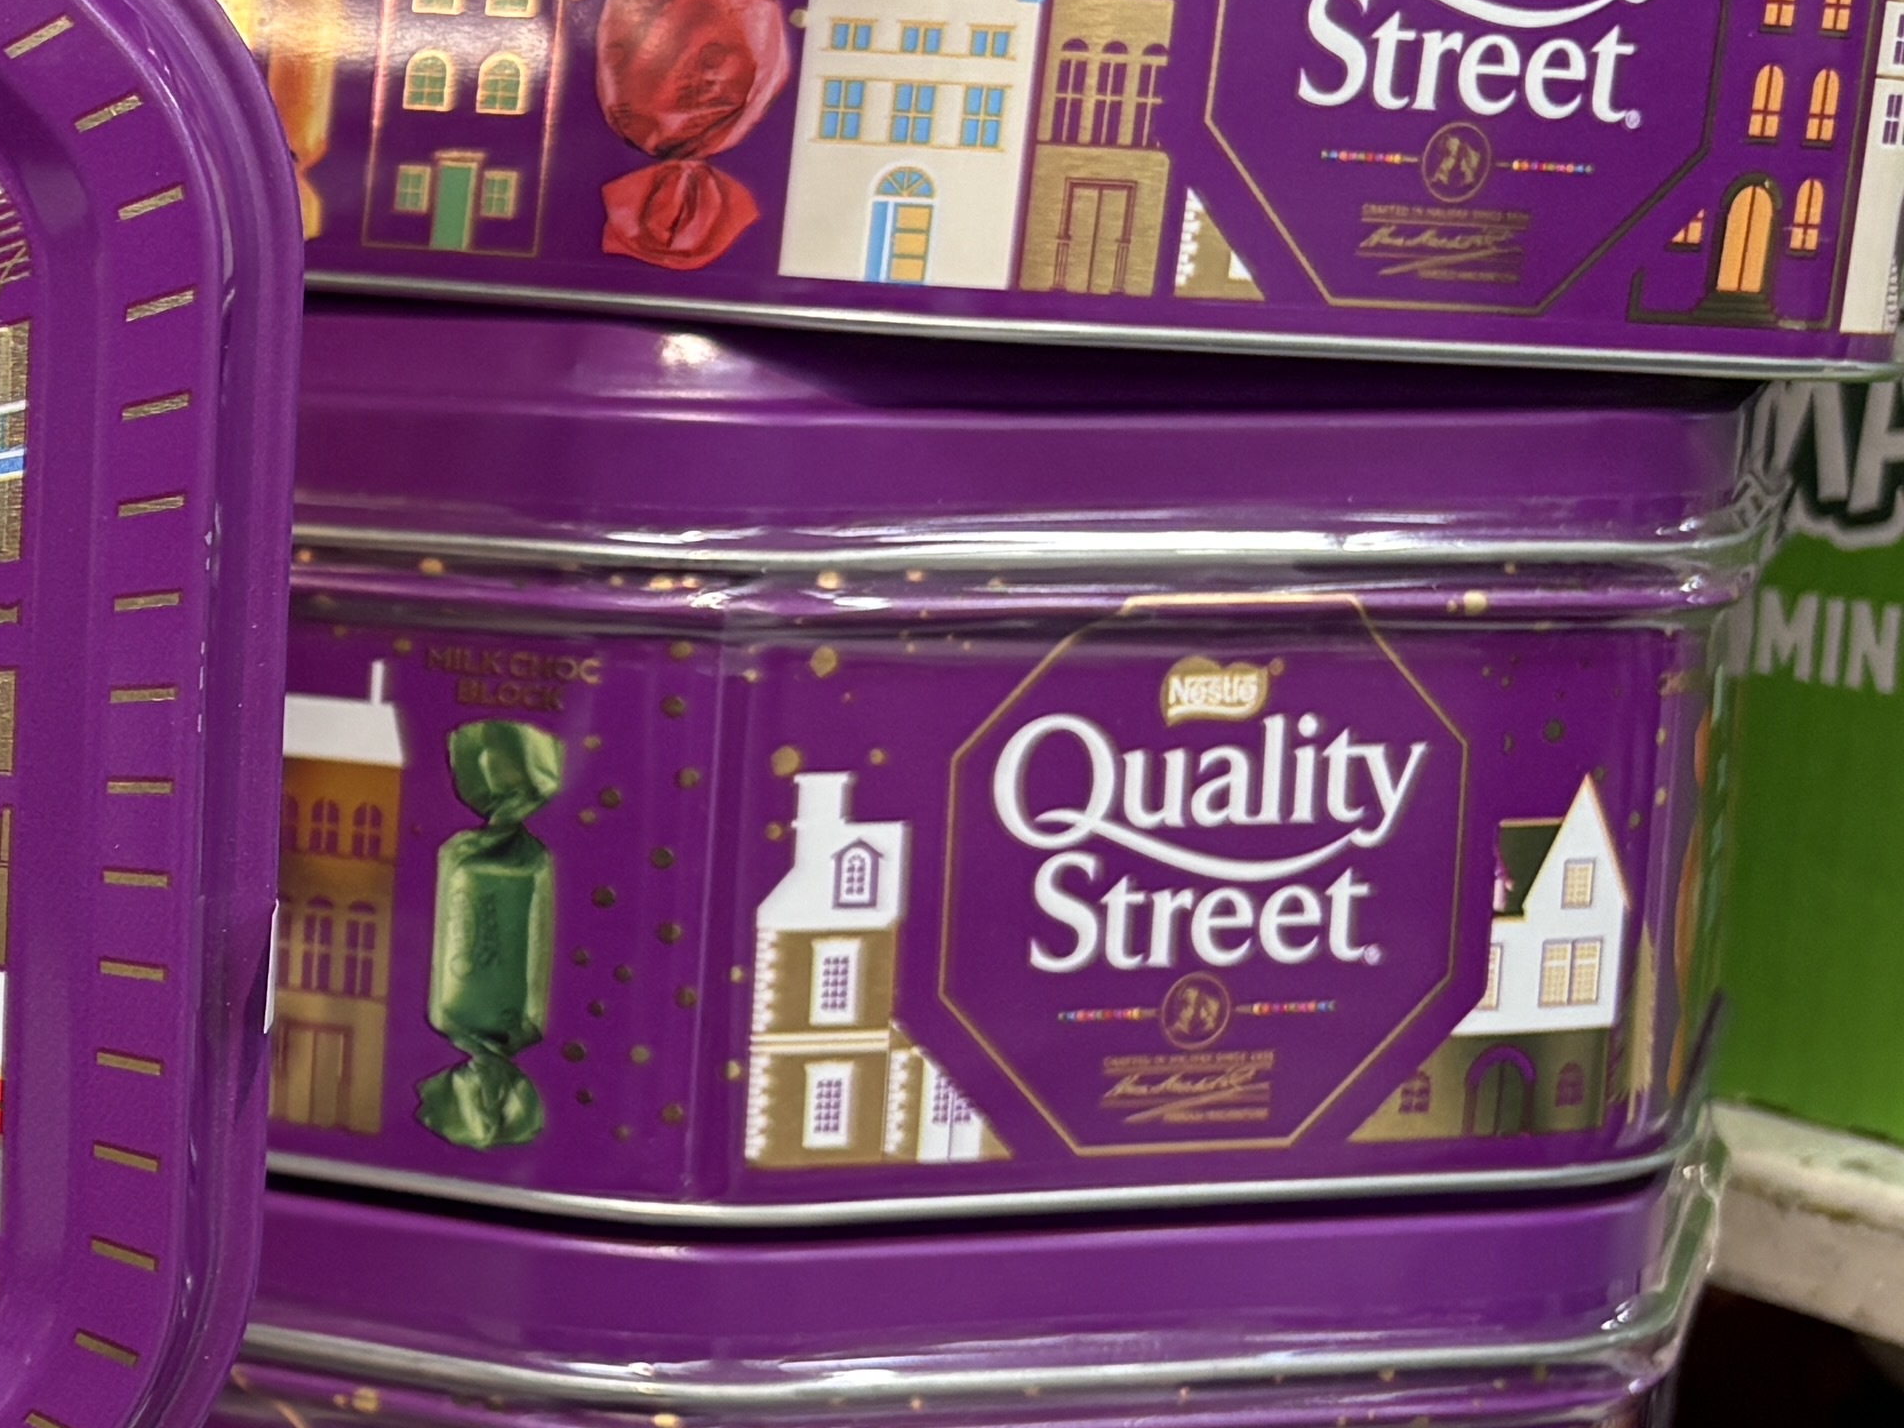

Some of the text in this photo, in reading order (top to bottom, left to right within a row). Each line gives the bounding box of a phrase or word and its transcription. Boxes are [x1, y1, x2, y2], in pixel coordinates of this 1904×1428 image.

[427, 646, 502, 677] MILK
[993, 713, 1429, 882] Quality
[1029, 851, 1372, 972] Street
